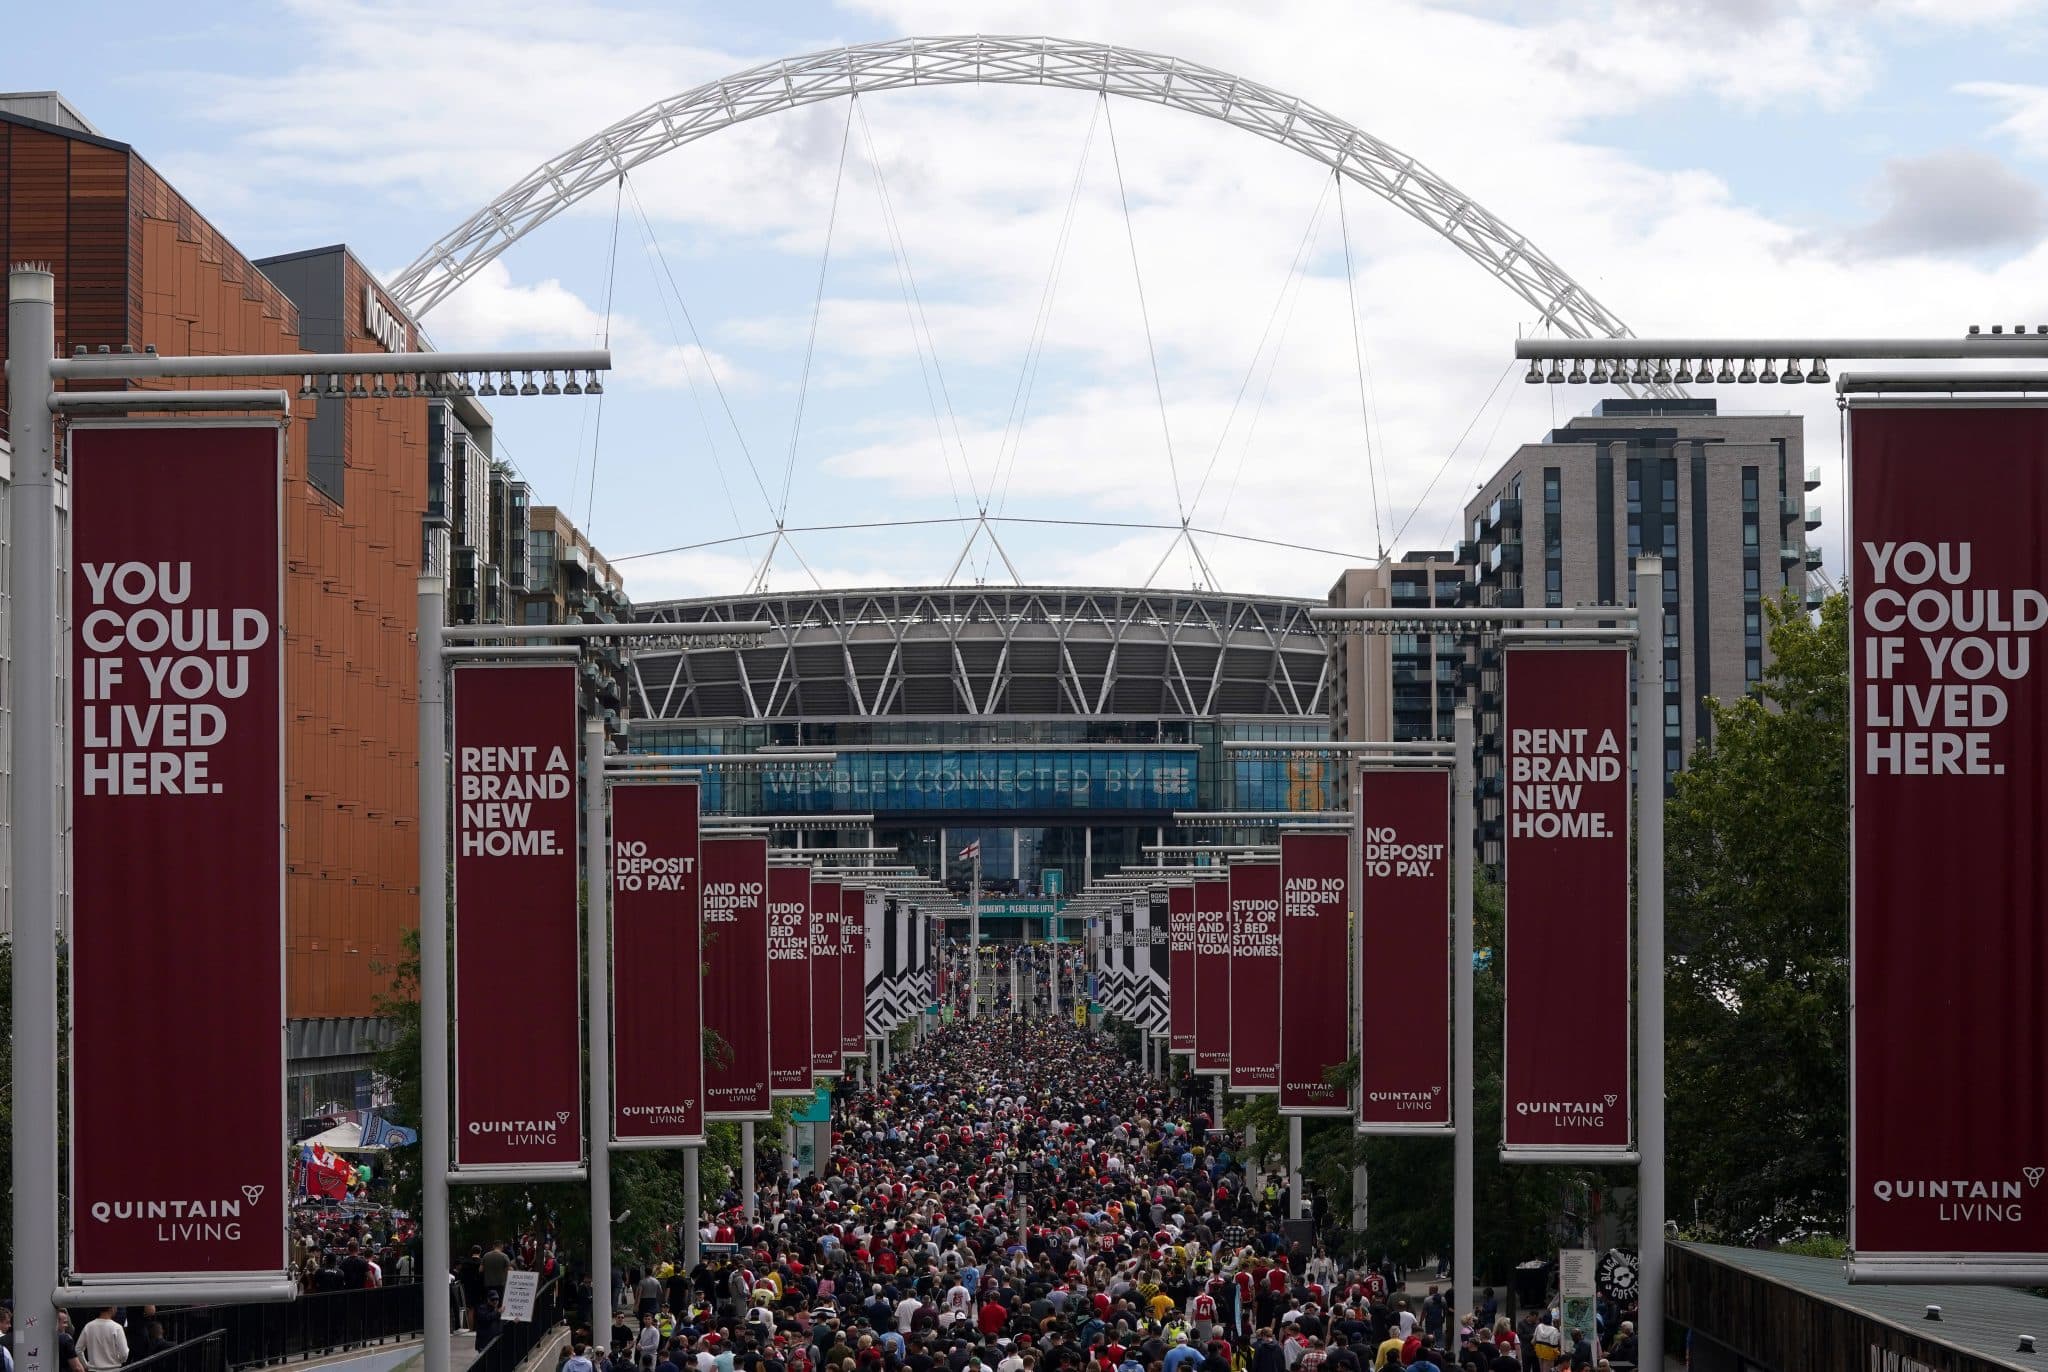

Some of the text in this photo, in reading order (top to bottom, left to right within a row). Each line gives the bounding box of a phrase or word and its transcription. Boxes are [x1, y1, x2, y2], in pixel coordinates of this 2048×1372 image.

[1862, 542, 1971, 584] YOU
[81, 562, 191, 604] YOU
[1864, 589, 2048, 632] COULD
[82, 609, 269, 652] COULD
[1866, 637, 2029, 679] IF YOU
[84, 656, 248, 699] IF YOU
[1867, 685, 2008, 726] LIVED
[84, 704, 226, 747] LIVED
[1512, 729, 1620, 753] RENT A
[462, 746, 570, 772] RENT A
[1867, 733, 2004, 774] HERE.
[84, 752, 222, 795] HERE.
[1512, 757, 1621, 781] BRAND
[462, 774, 570, 800] BRAND
[769, 770, 907, 793] WEMBLEY
[915, 770, 1090, 792] CONNECTED
[1105, 768, 1142, 792] BY
[1512, 785, 1582, 810] NEW
[463, 803, 531, 828] NEW
[1512, 813, 1614, 838] HOME.
[1366, 827, 1396, 843] NO
[463, 830, 564, 857] HOME.
[617, 841, 647, 857] NO
[1366, 844, 1443, 860] DEPOSIT
[617, 858, 694, 874] DEPOSIT
[1366, 861, 1434, 877] TO PAY.
[617, 875, 685, 891] TO PAY.
[703, 883, 763, 896] AND NO
[1285, 878, 1345, 891] AND NO
[703, 896, 758, 909] HIDDEN
[1285, 891, 1340, 904] HIDDEN
[768, 903, 805, 914] TUDIO
[1232, 900, 1279, 911] STUDIO
[1285, 904, 1319, 917] FEES.
[703, 909, 738, 922] FEES.
[771, 914, 802, 925] 2 OR
[826, 912, 839, 923] IN
[1197, 911, 1223, 922] POP
[1245, 911, 1254, 923] 2
[1257, 911, 1277, 923] OR
[770, 926, 794, 937] BED
[1171, 923, 1196, 932] WHE
[1197, 923, 1224, 933] AND
[1232, 923, 1268, 934] 3 BED
[768, 937, 808, 948] TYLISH
[1171, 932, 1194, 942] YOU
[1197, 933, 1229, 943] VIEW
[1232, 935, 1281, 946] STYLISH
[769, 949, 808, 960] OMES.
[814, 945, 839, 956] DAY.
[1197, 944, 1230, 955] TODA
[1233, 946, 1281, 957] HOMES.
[707, 1087, 756, 1096] QUINTAIN
[1369, 1092, 1432, 1101] QUINTAIN
[622, 1106, 685, 1117] QUINTAIN
[1396, 1101, 1432, 1110] LIVING
[1516, 1102, 1604, 1115] QUINTAIN
[650, 1115, 685, 1125] LIVING
[1555, 1115, 1604, 1127] LIVING
[468, 1120, 556, 1134] QUINTAIN
[507, 1134, 557, 1146] LIVING
[1873, 1180, 2022, 1202] QUINTAIN
[91, 1199, 240, 1223] QUINTAIN
[1940, 1203, 2022, 1222] LIVING
[158, 1223, 241, 1241] LIVING
[1049, 1238, 1058, 1248] 10
[966, 1274, 973, 1283] 9
[1371, 1280, 1379, 1291] 8
[1200, 1303, 1211, 1316] 41
